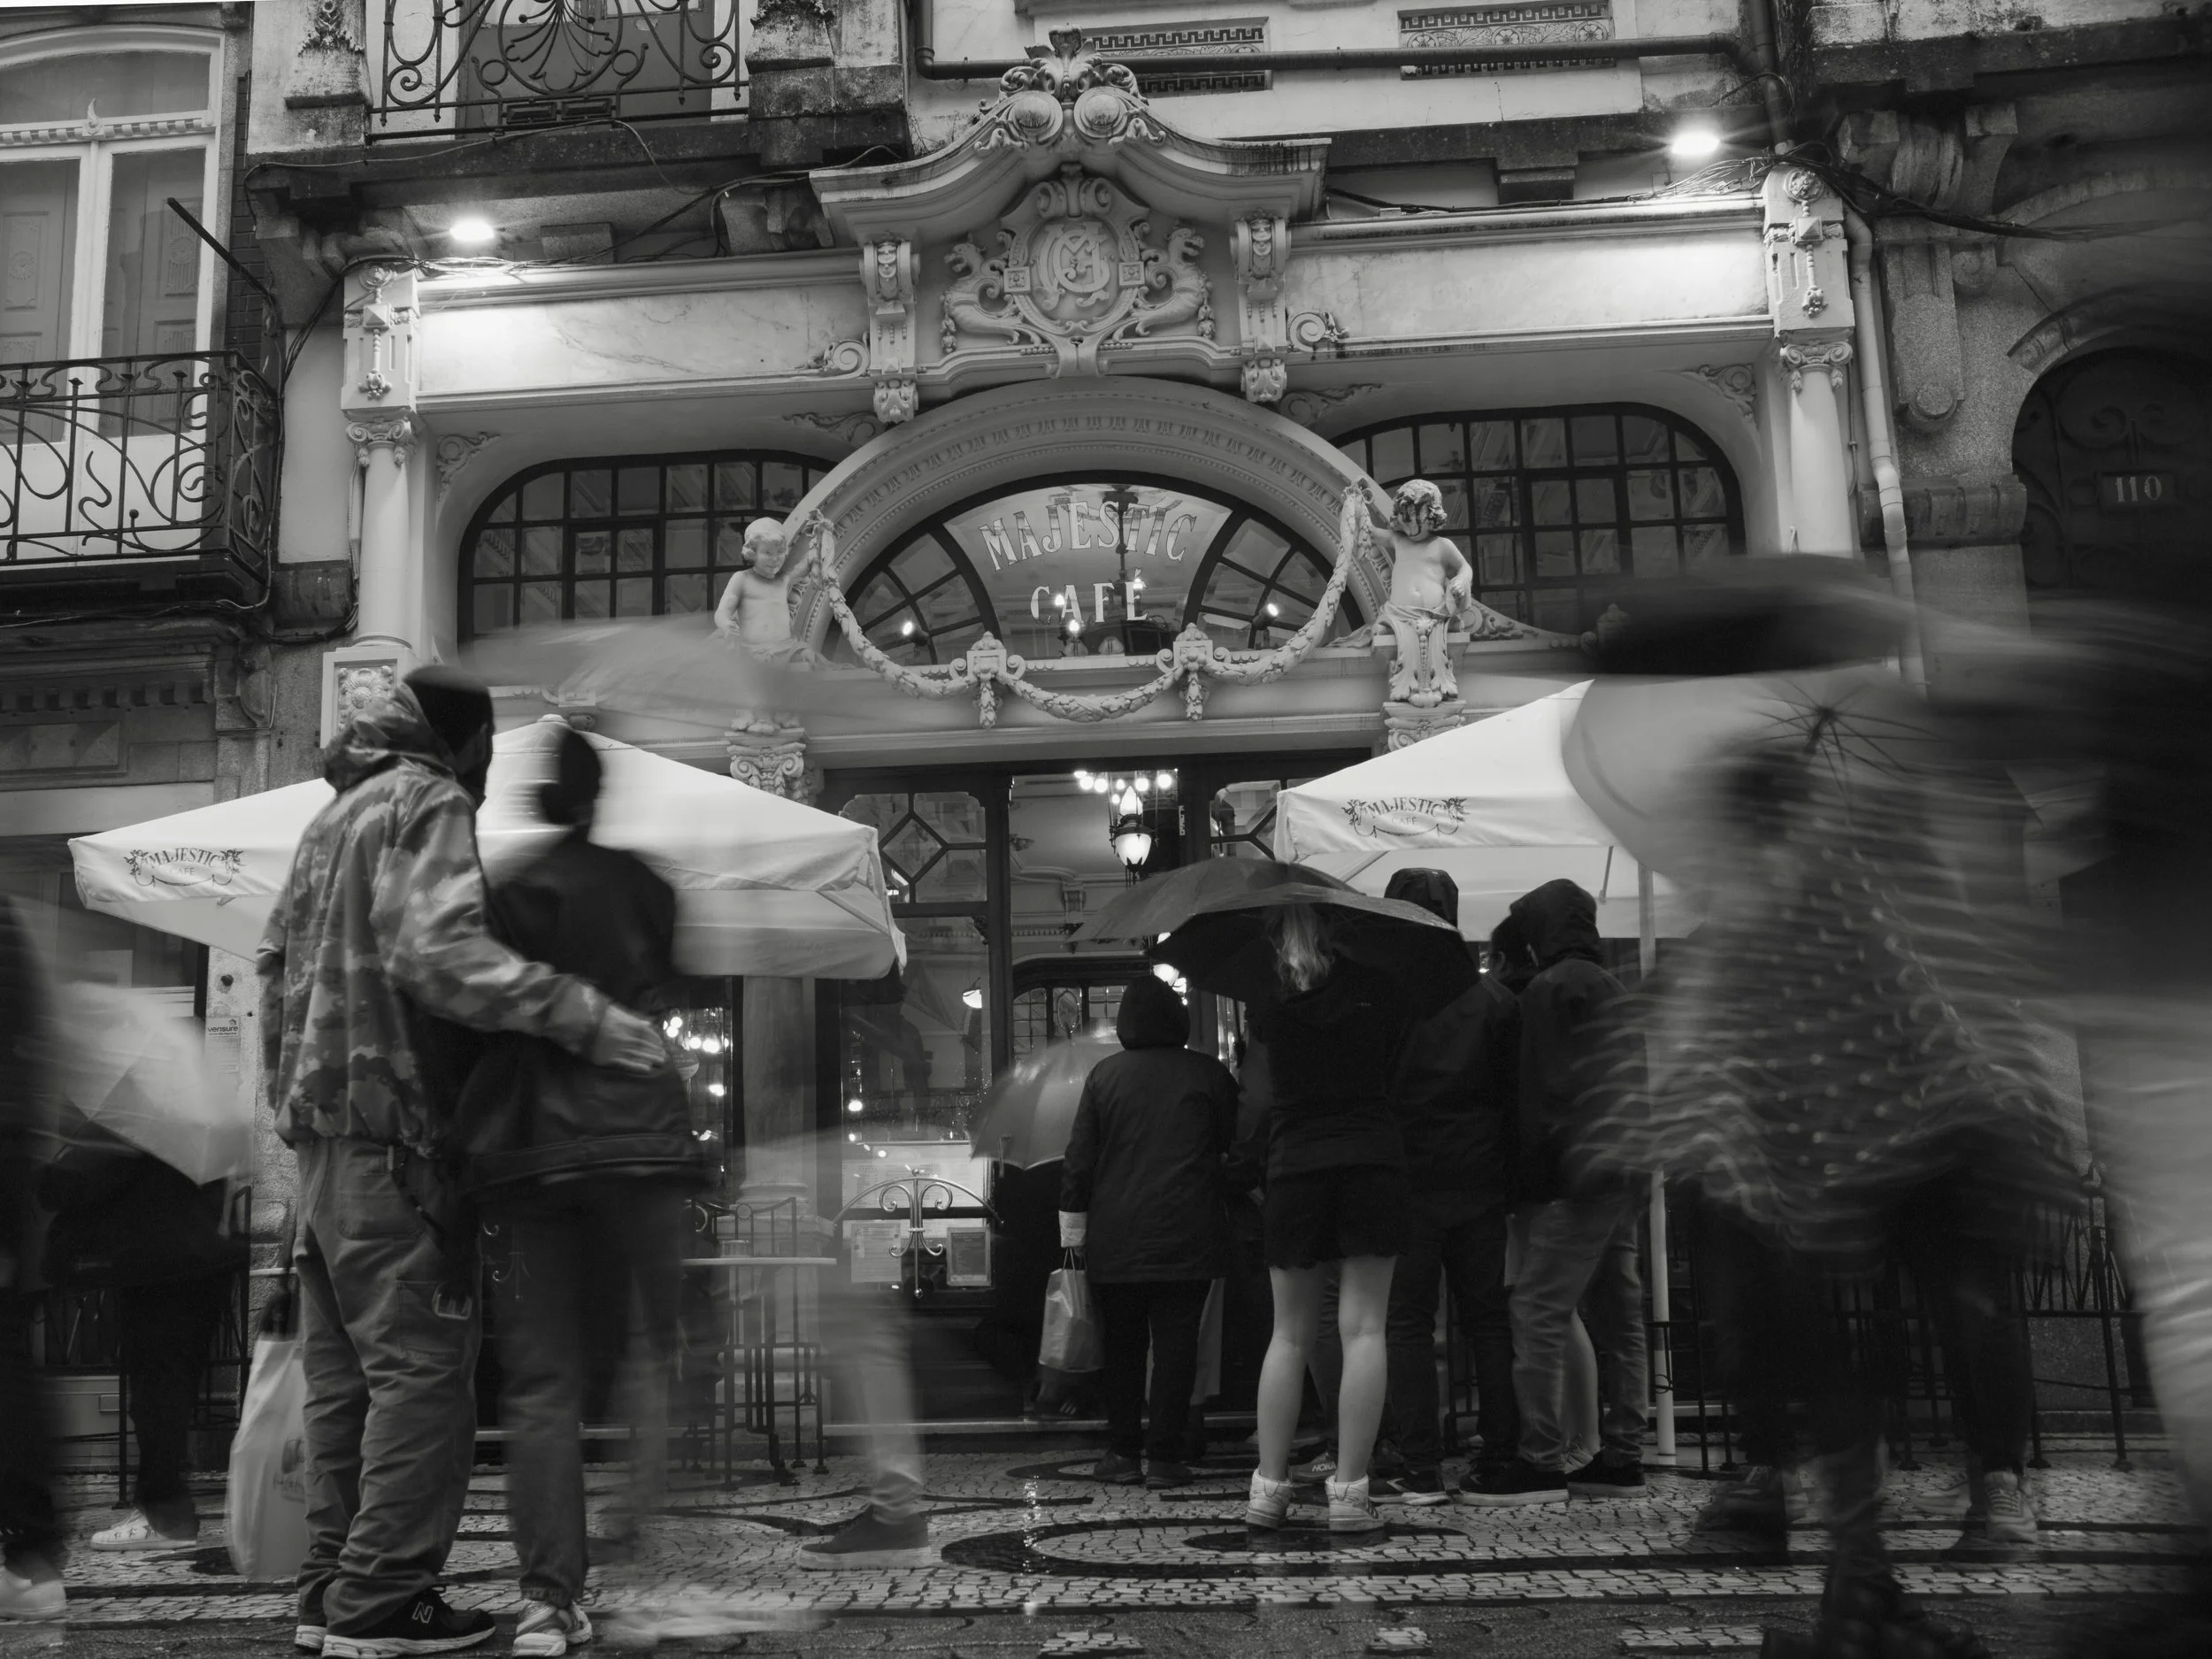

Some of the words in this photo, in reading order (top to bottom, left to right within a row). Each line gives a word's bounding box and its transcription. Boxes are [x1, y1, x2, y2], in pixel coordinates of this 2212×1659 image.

[2116, 475, 2162, 503] 110
[978, 500, 1197, 572] MAJESTIC
[1365, 797, 1442, 818] MAJESTIC
[148, 847, 221, 868] MAJESTIC
